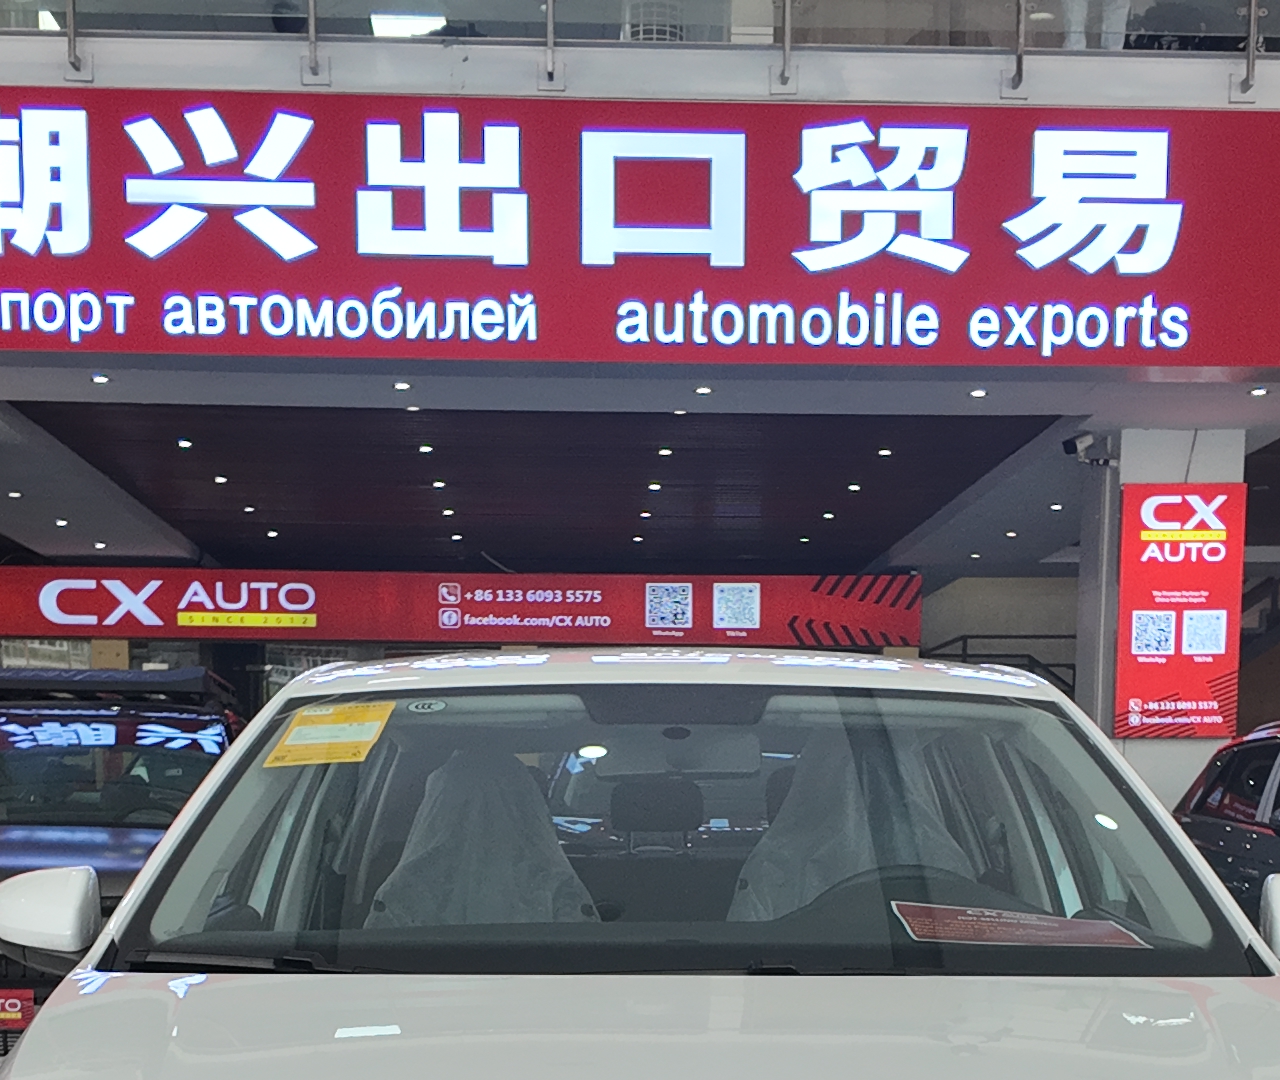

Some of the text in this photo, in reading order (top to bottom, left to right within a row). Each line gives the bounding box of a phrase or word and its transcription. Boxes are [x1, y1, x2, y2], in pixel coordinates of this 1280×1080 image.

[163, 286, 538, 342] автомобилей
[615, 290, 1189, 357] automobile exports
[1140, 494, 1228, 531] CX
[1140, 541, 1226, 563] AUTO
[38, 579, 316, 626] CX AUTO
[464, 589, 602, 603] +86 133 6093 5575
[574, 615, 612, 627] AUTO
